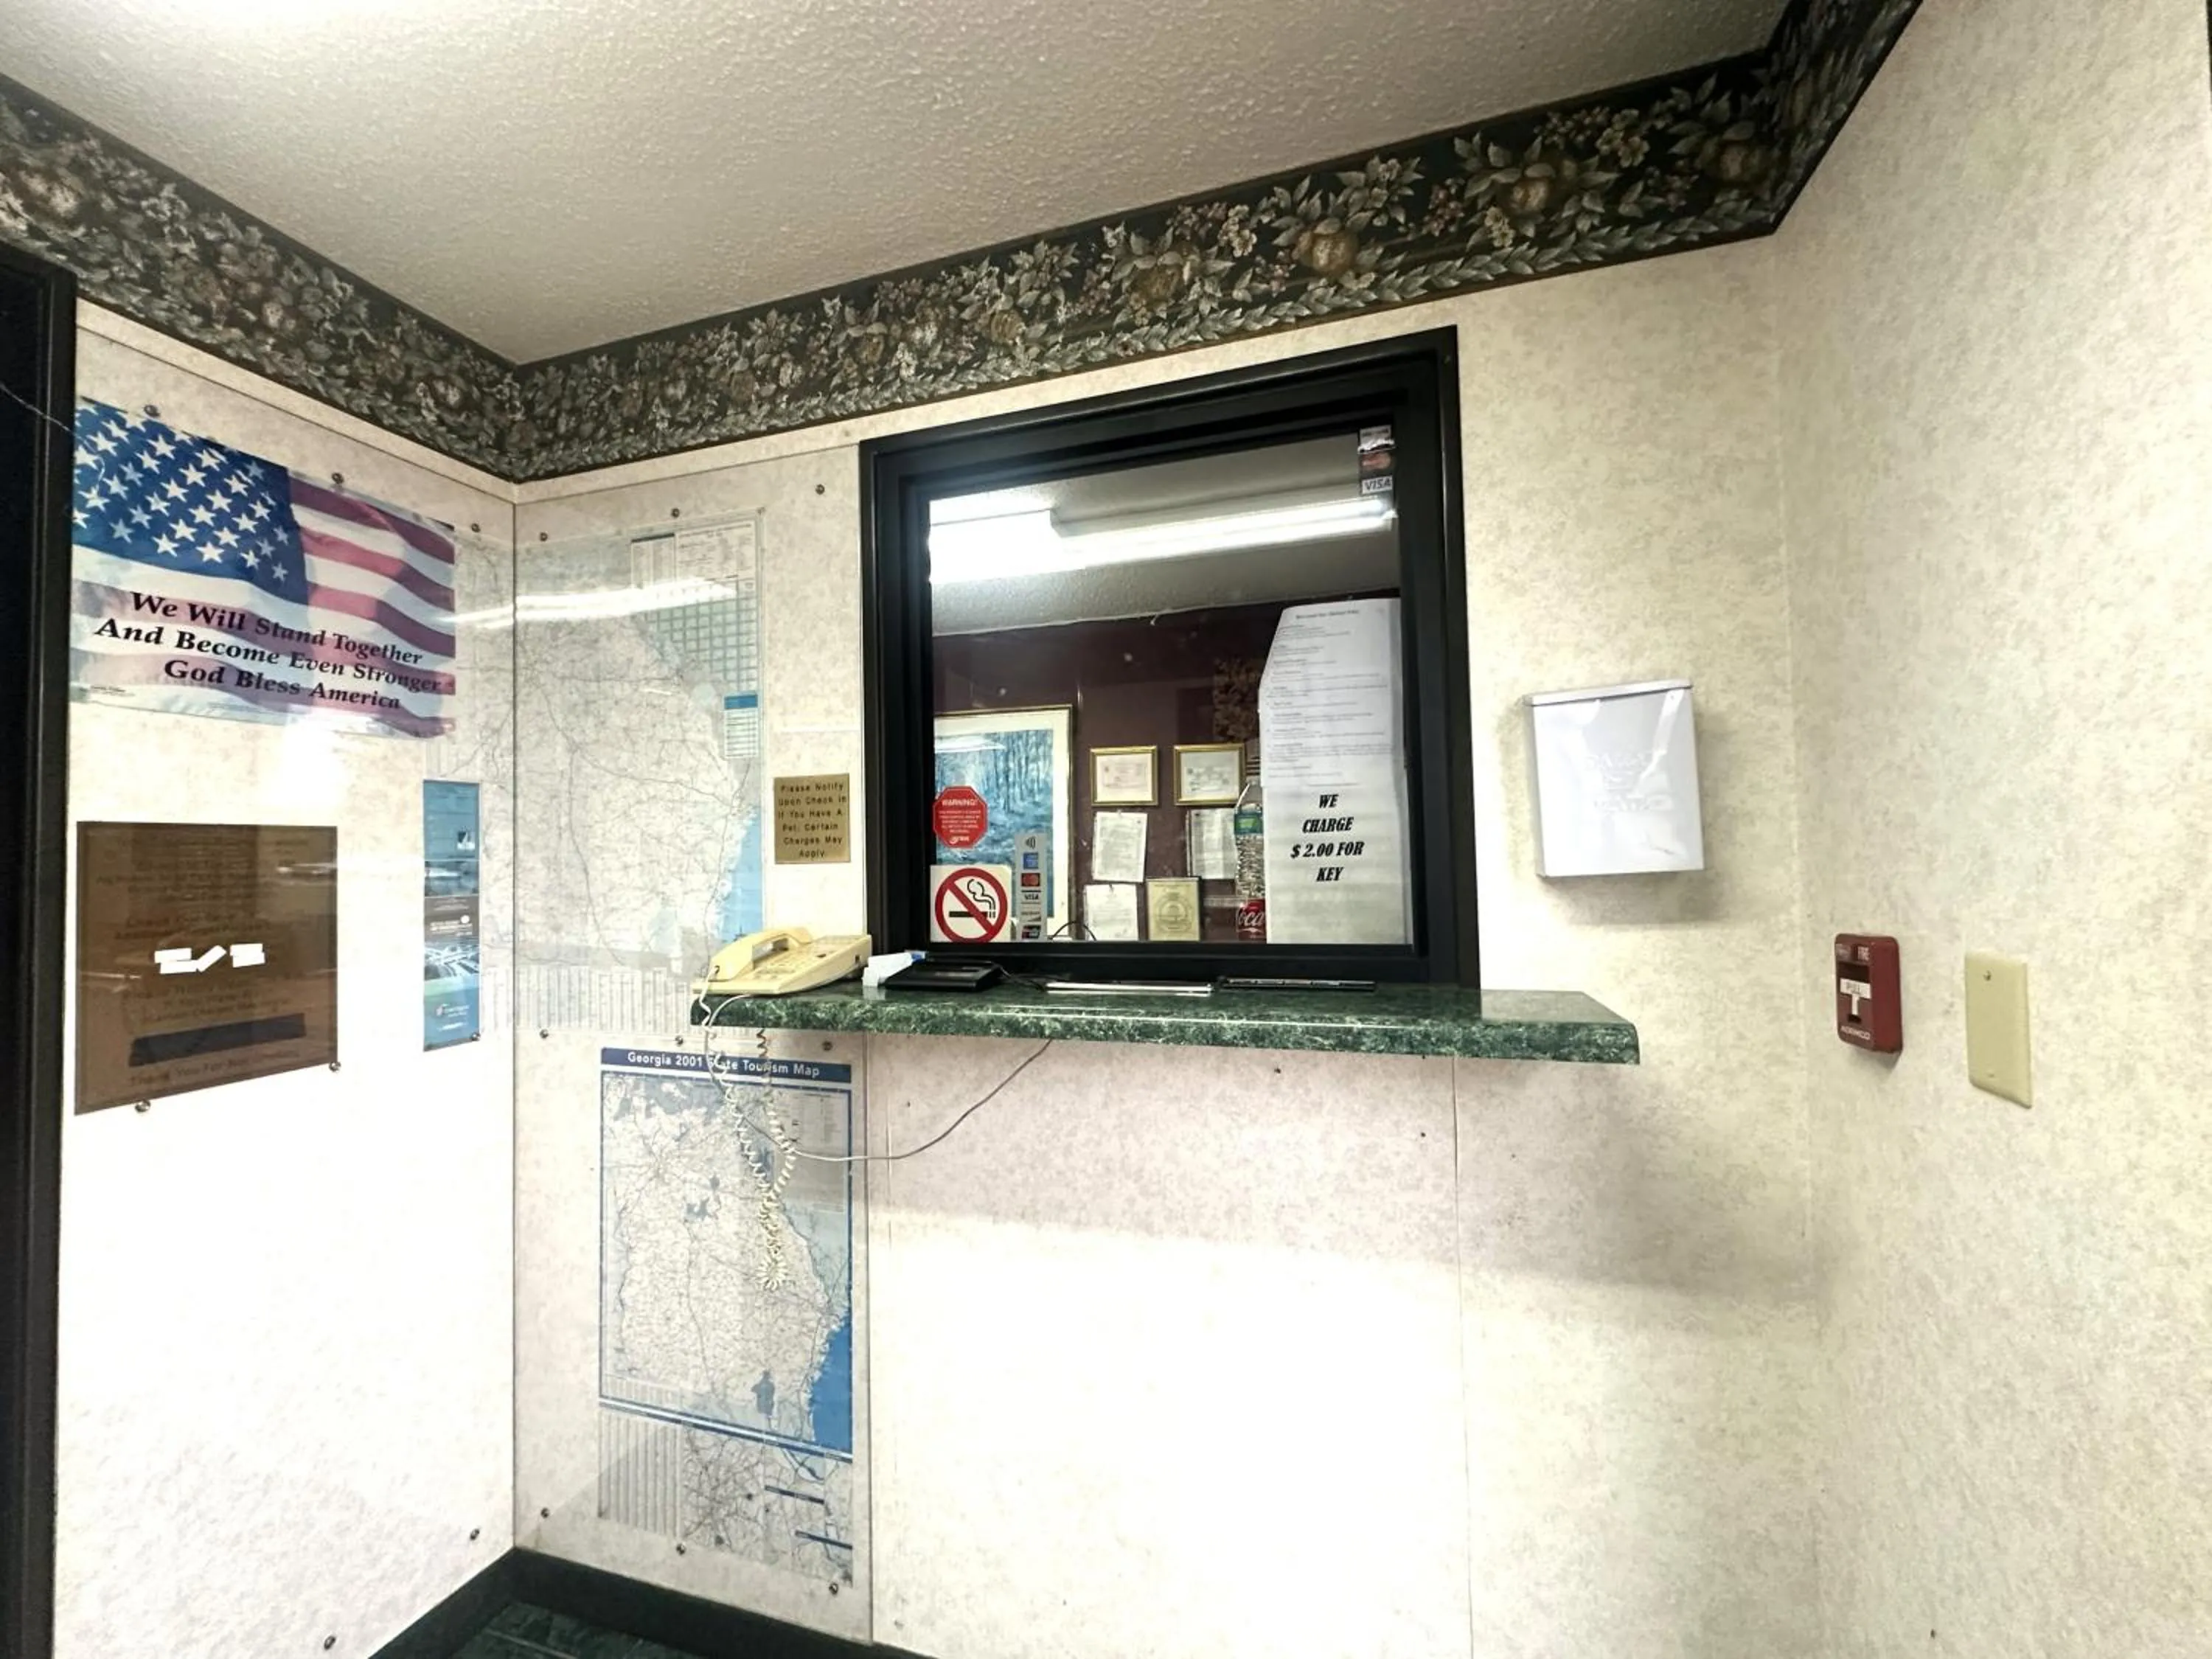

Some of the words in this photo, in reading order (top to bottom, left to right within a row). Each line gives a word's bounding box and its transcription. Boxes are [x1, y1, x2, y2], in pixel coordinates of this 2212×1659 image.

[1364, 478, 1391, 490] VISA
[130, 591, 178, 617] We
[187, 602, 246, 630] Will
[255, 616, 327, 647] Stand
[333, 632, 423, 664] Together
[94, 618, 164, 645] And
[175, 630, 279, 665] Become
[289, 651, 344, 675] Even
[353, 663, 442, 693] Stronger
[164, 660, 225, 684] God
[234, 668, 301, 695] Bless
[309, 682, 402, 709] America
[780, 784, 810, 793] Please
[815, 782, 844, 792] Notify
[804, 796, 833, 806] Check
[1318, 793, 1340, 809] WE
[809, 810, 831, 818] Have
[835, 808, 843, 816] A
[804, 822, 838, 831] Certain
[1302, 816, 1354, 834] CHARGE
[782, 836, 820, 846] Charges
[824, 835, 843, 844] May
[799, 849, 825, 859] Apply
[1290, 844, 1301, 859] $
[1302, 843, 1334, 858] 2.00
[1335, 841, 1365, 856] FOR
[1315, 866, 1344, 883] KEY
[627, 1051, 672, 1067] Georgia
[675, 1054, 703, 1068] 2001
[708, 1054, 738, 1071] Sate
[793, 1066, 820, 1079] Map
